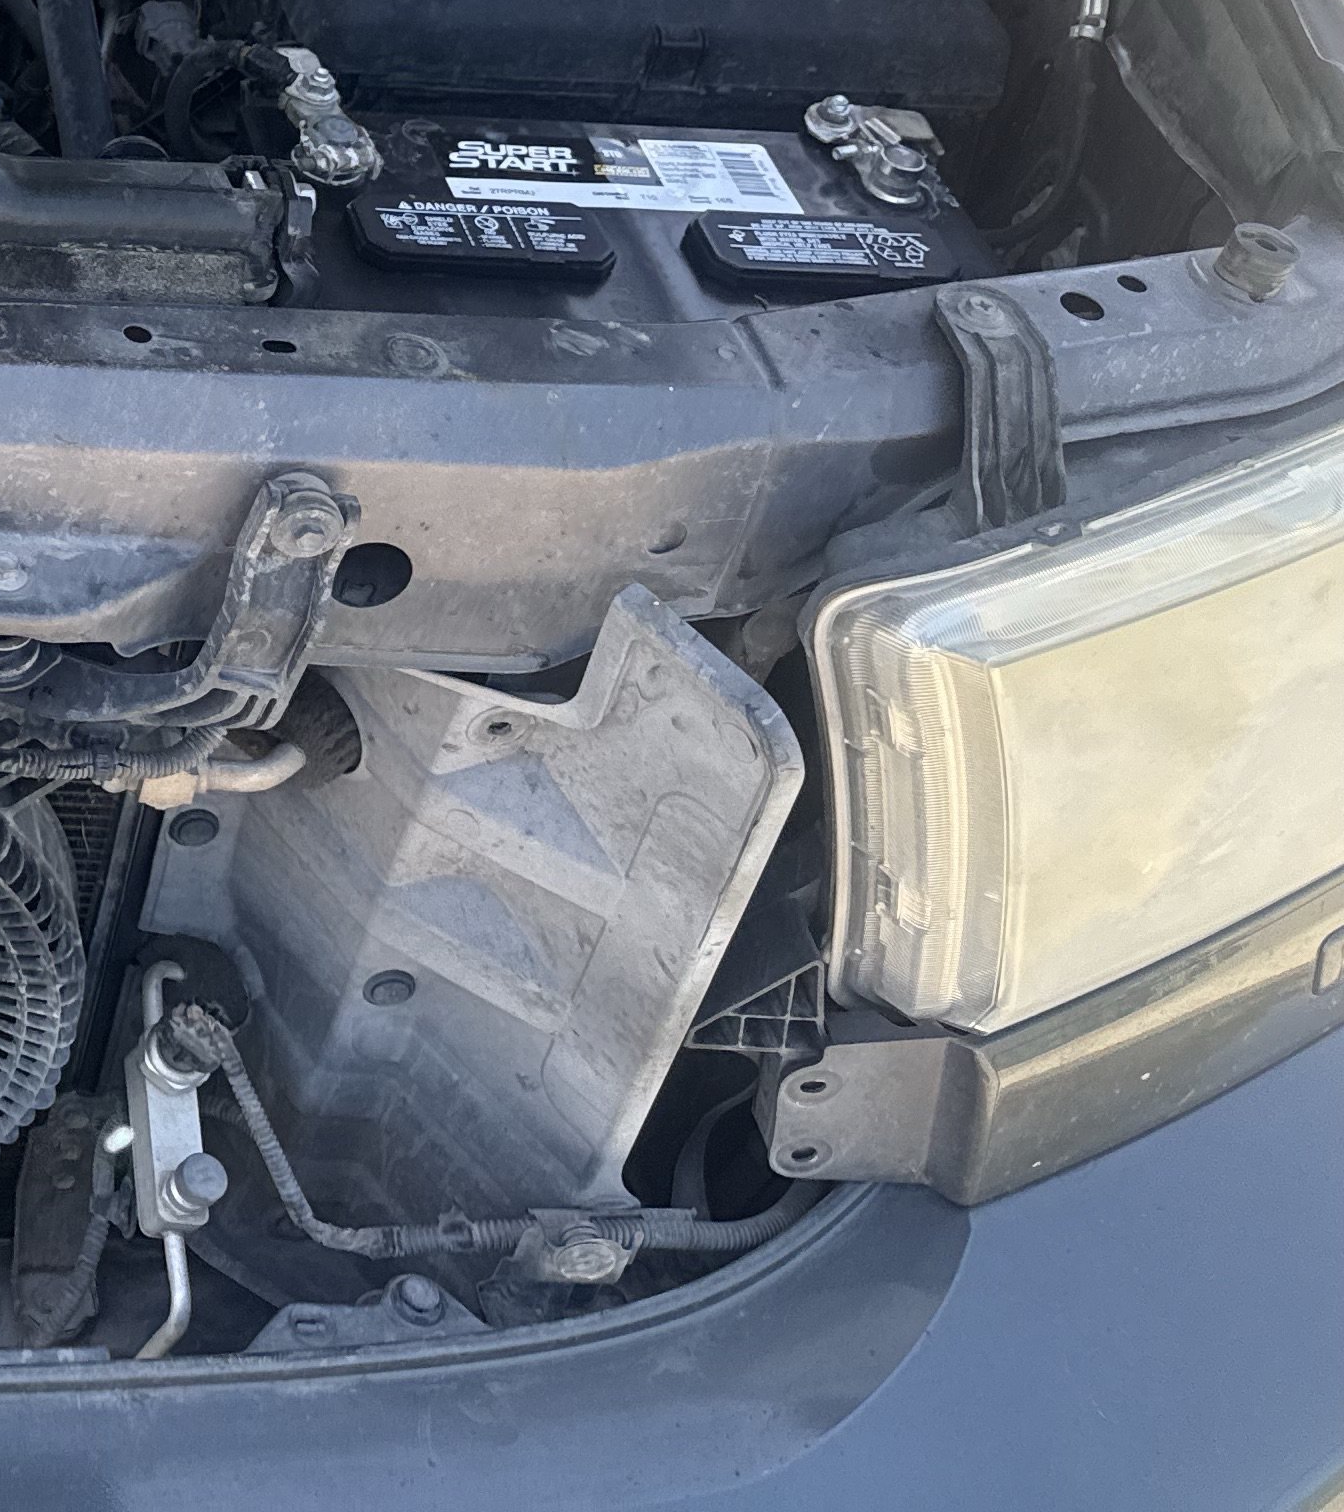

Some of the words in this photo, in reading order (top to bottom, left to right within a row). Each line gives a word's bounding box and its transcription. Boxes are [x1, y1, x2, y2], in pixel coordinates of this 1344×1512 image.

[457, 140, 573, 159] SUPER
[448, 151, 578, 172] START
[413, 201, 477, 213] DANGER
[493, 204, 550, 216] POISON
